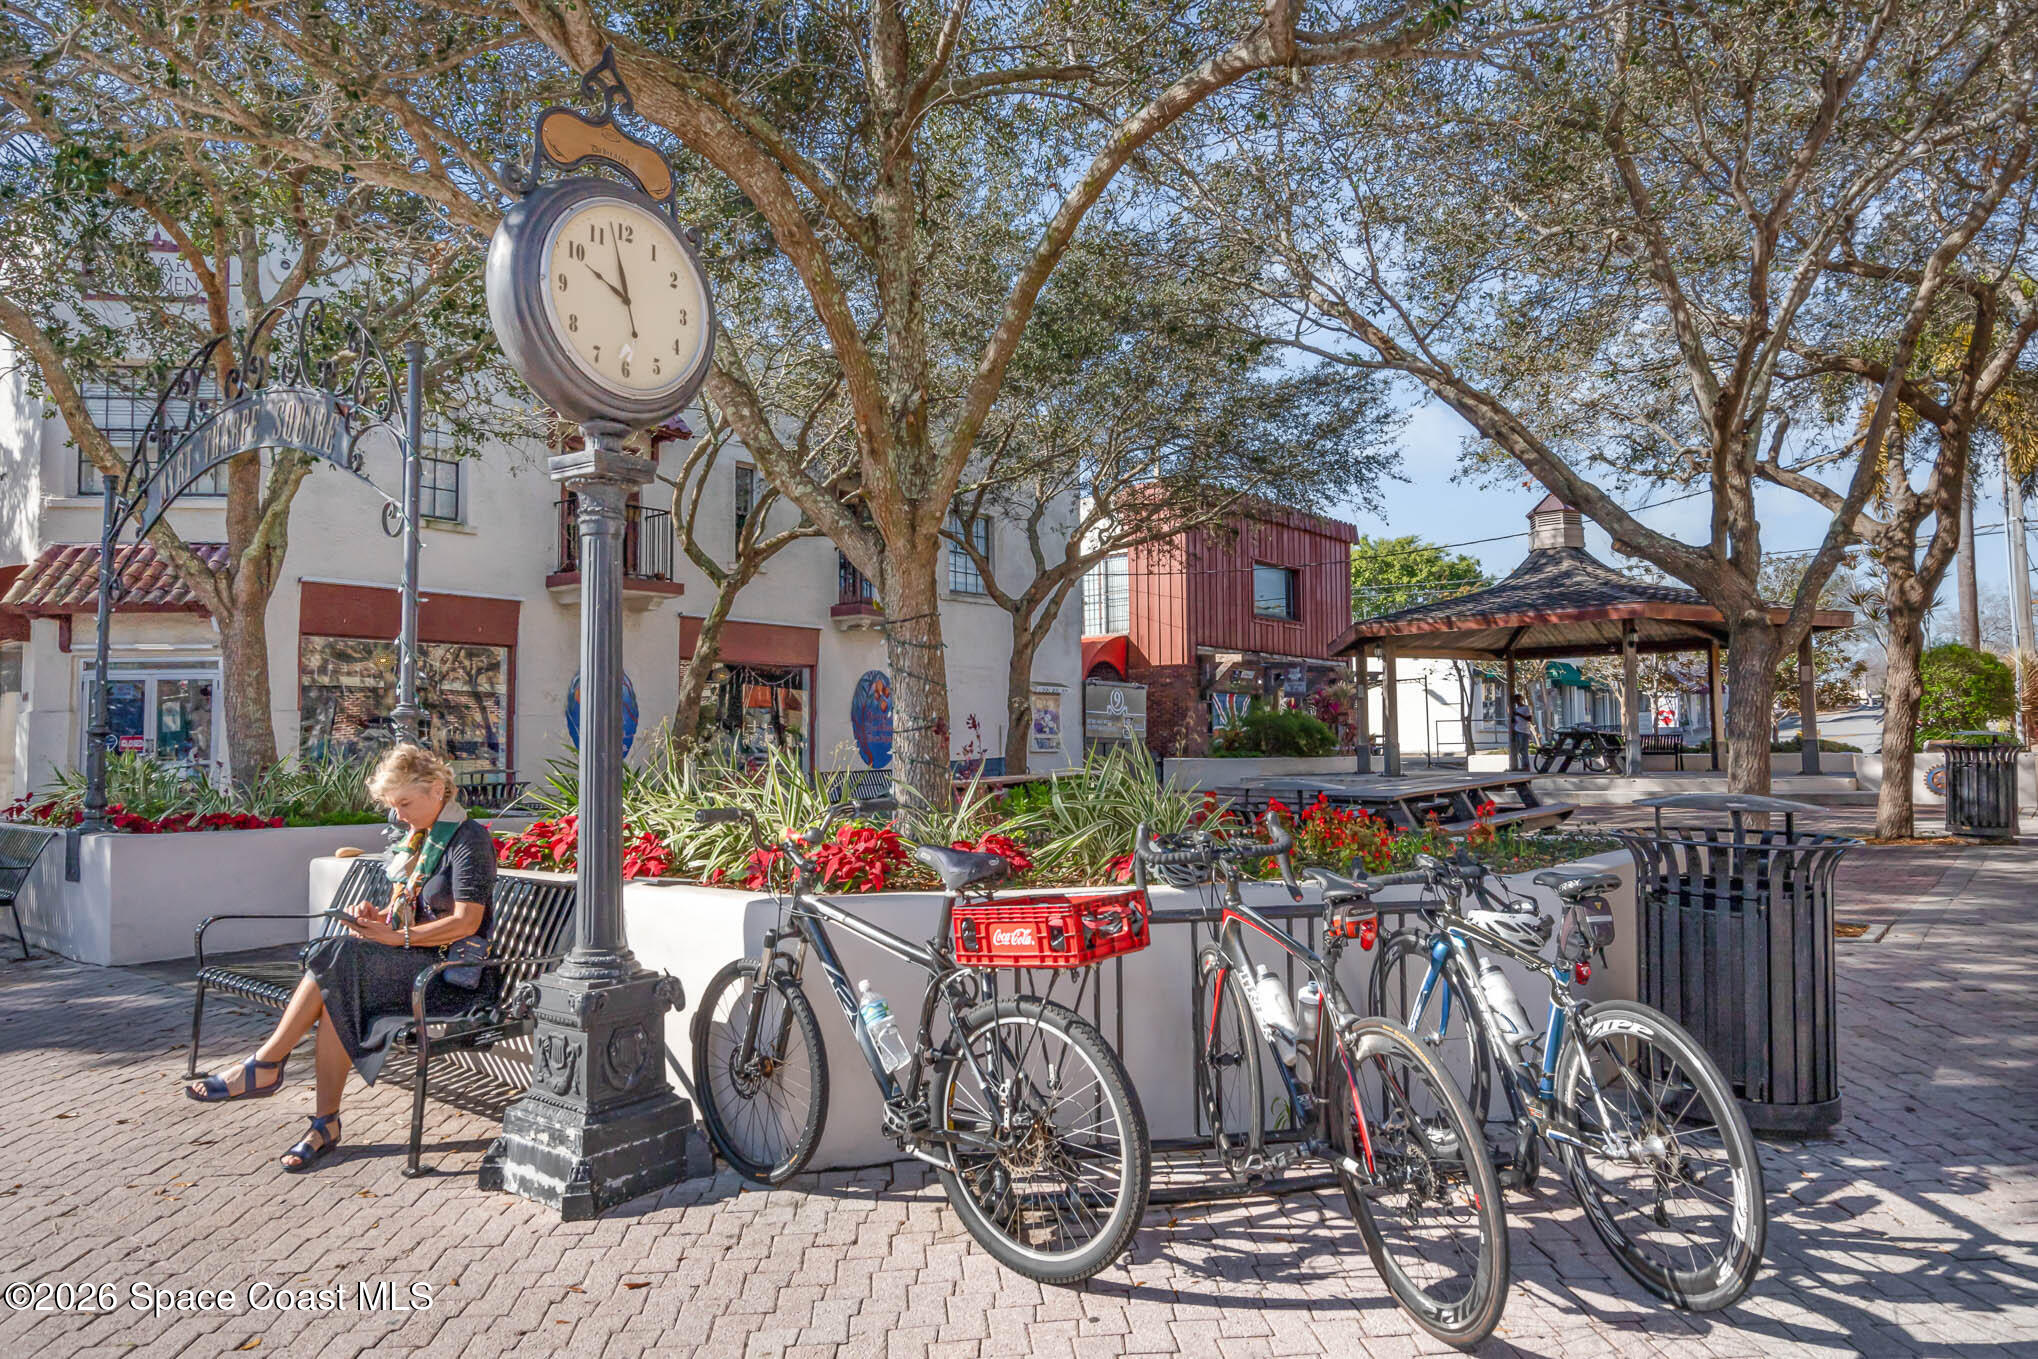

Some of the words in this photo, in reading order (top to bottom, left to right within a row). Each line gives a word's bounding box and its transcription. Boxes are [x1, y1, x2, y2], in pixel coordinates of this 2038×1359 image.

[590, 224, 604, 246] 11
[618, 223, 633, 244] 12
[568, 240, 585, 262] 10
[651, 244, 657, 262] 1
[558, 273, 568, 292] 9
[669, 271, 679, 289] 2
[568, 314, 578, 333] 8
[680, 309, 687, 326] 3
[593, 345, 601, 364] 7
[672, 338, 679, 355] 4
[621, 360, 630, 378] 6
[652, 357, 661, 375] 5
[203, 405, 261, 466] THARPE
[271, 400, 341, 454] SQUARE
